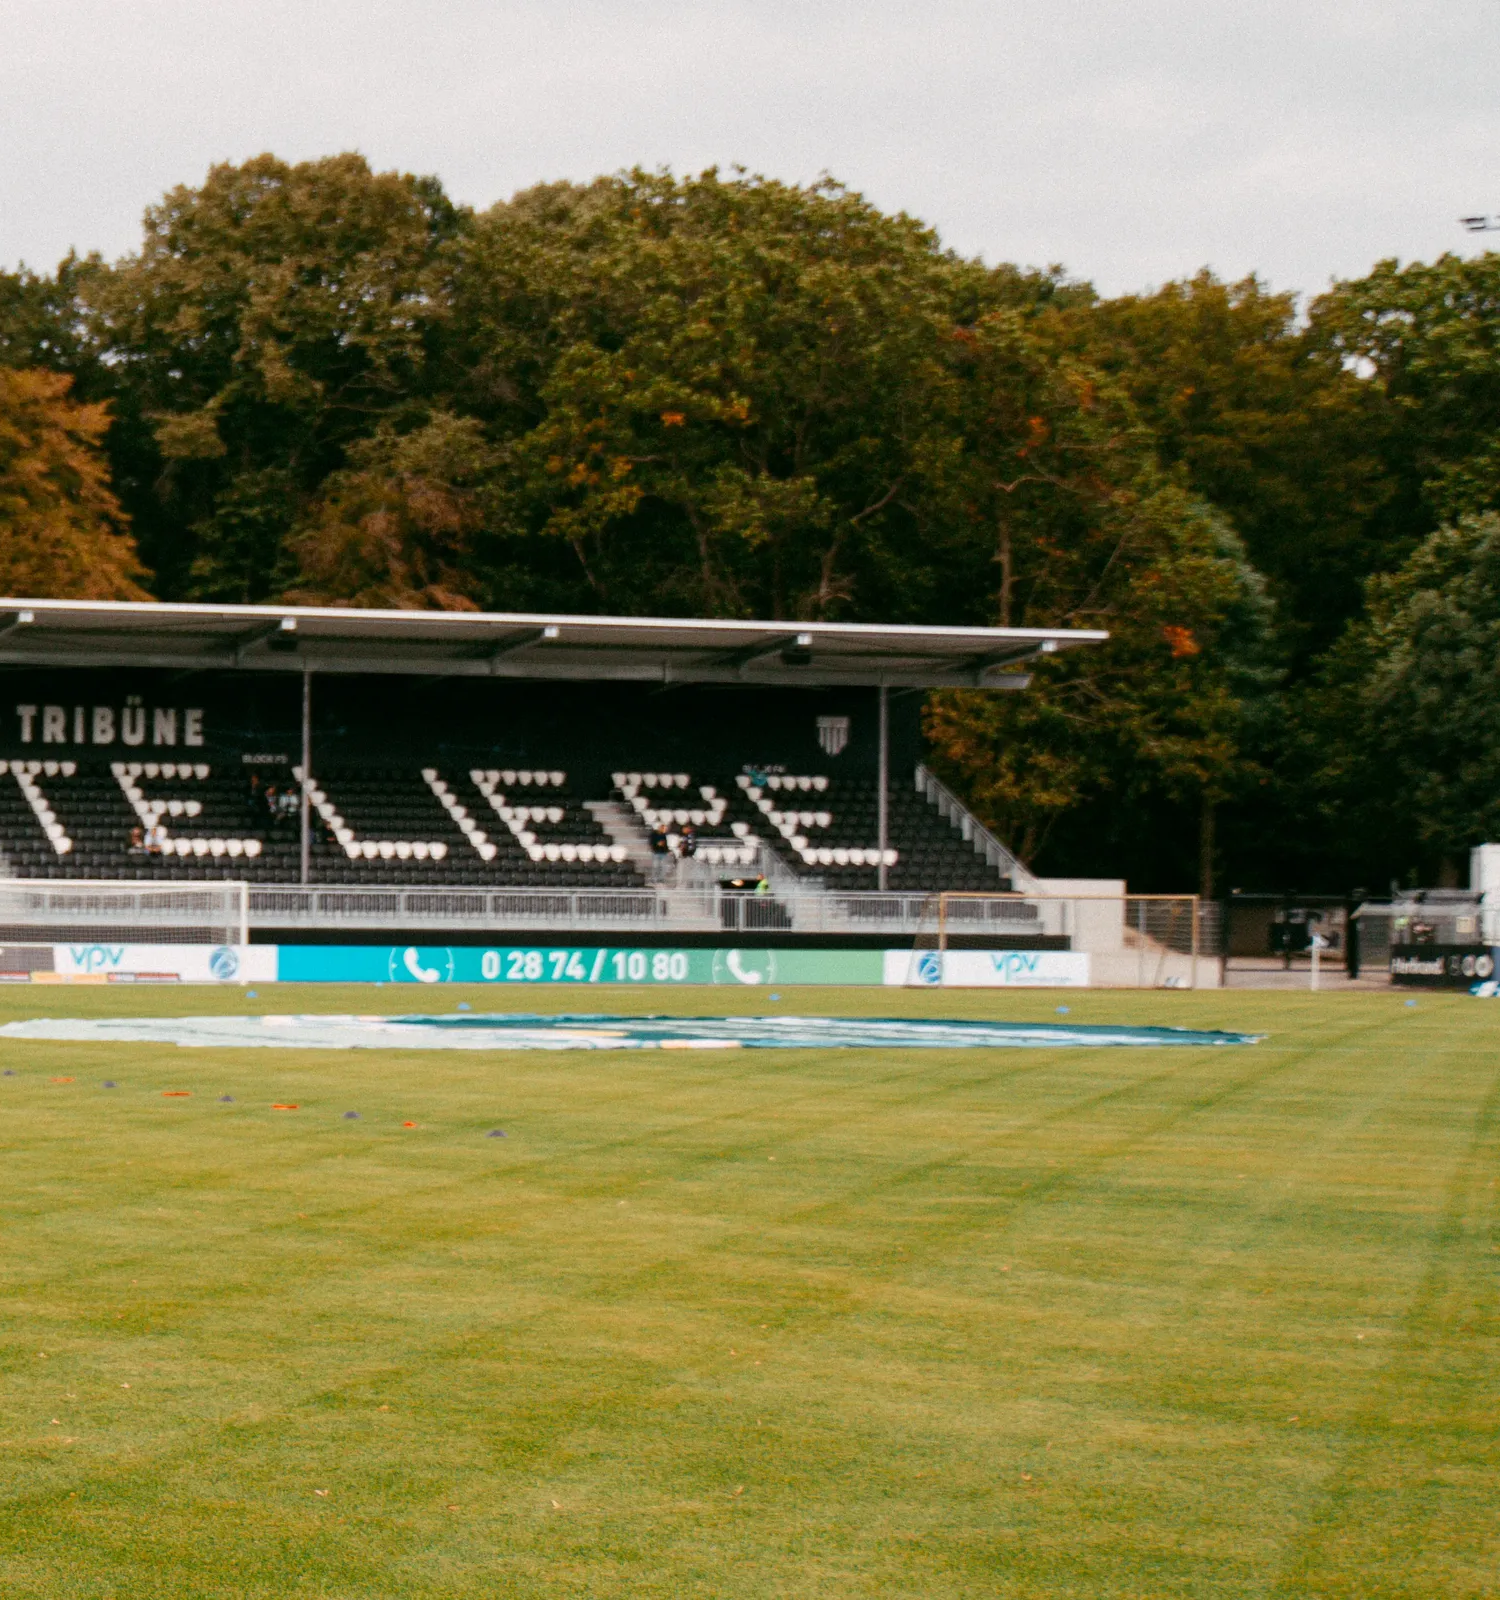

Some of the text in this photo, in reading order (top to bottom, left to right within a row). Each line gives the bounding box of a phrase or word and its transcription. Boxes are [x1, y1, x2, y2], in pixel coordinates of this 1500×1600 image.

[16, 696, 205, 746] TRIBÜNE
[481, 949, 689, 982] 0 28 74 / 10 80
